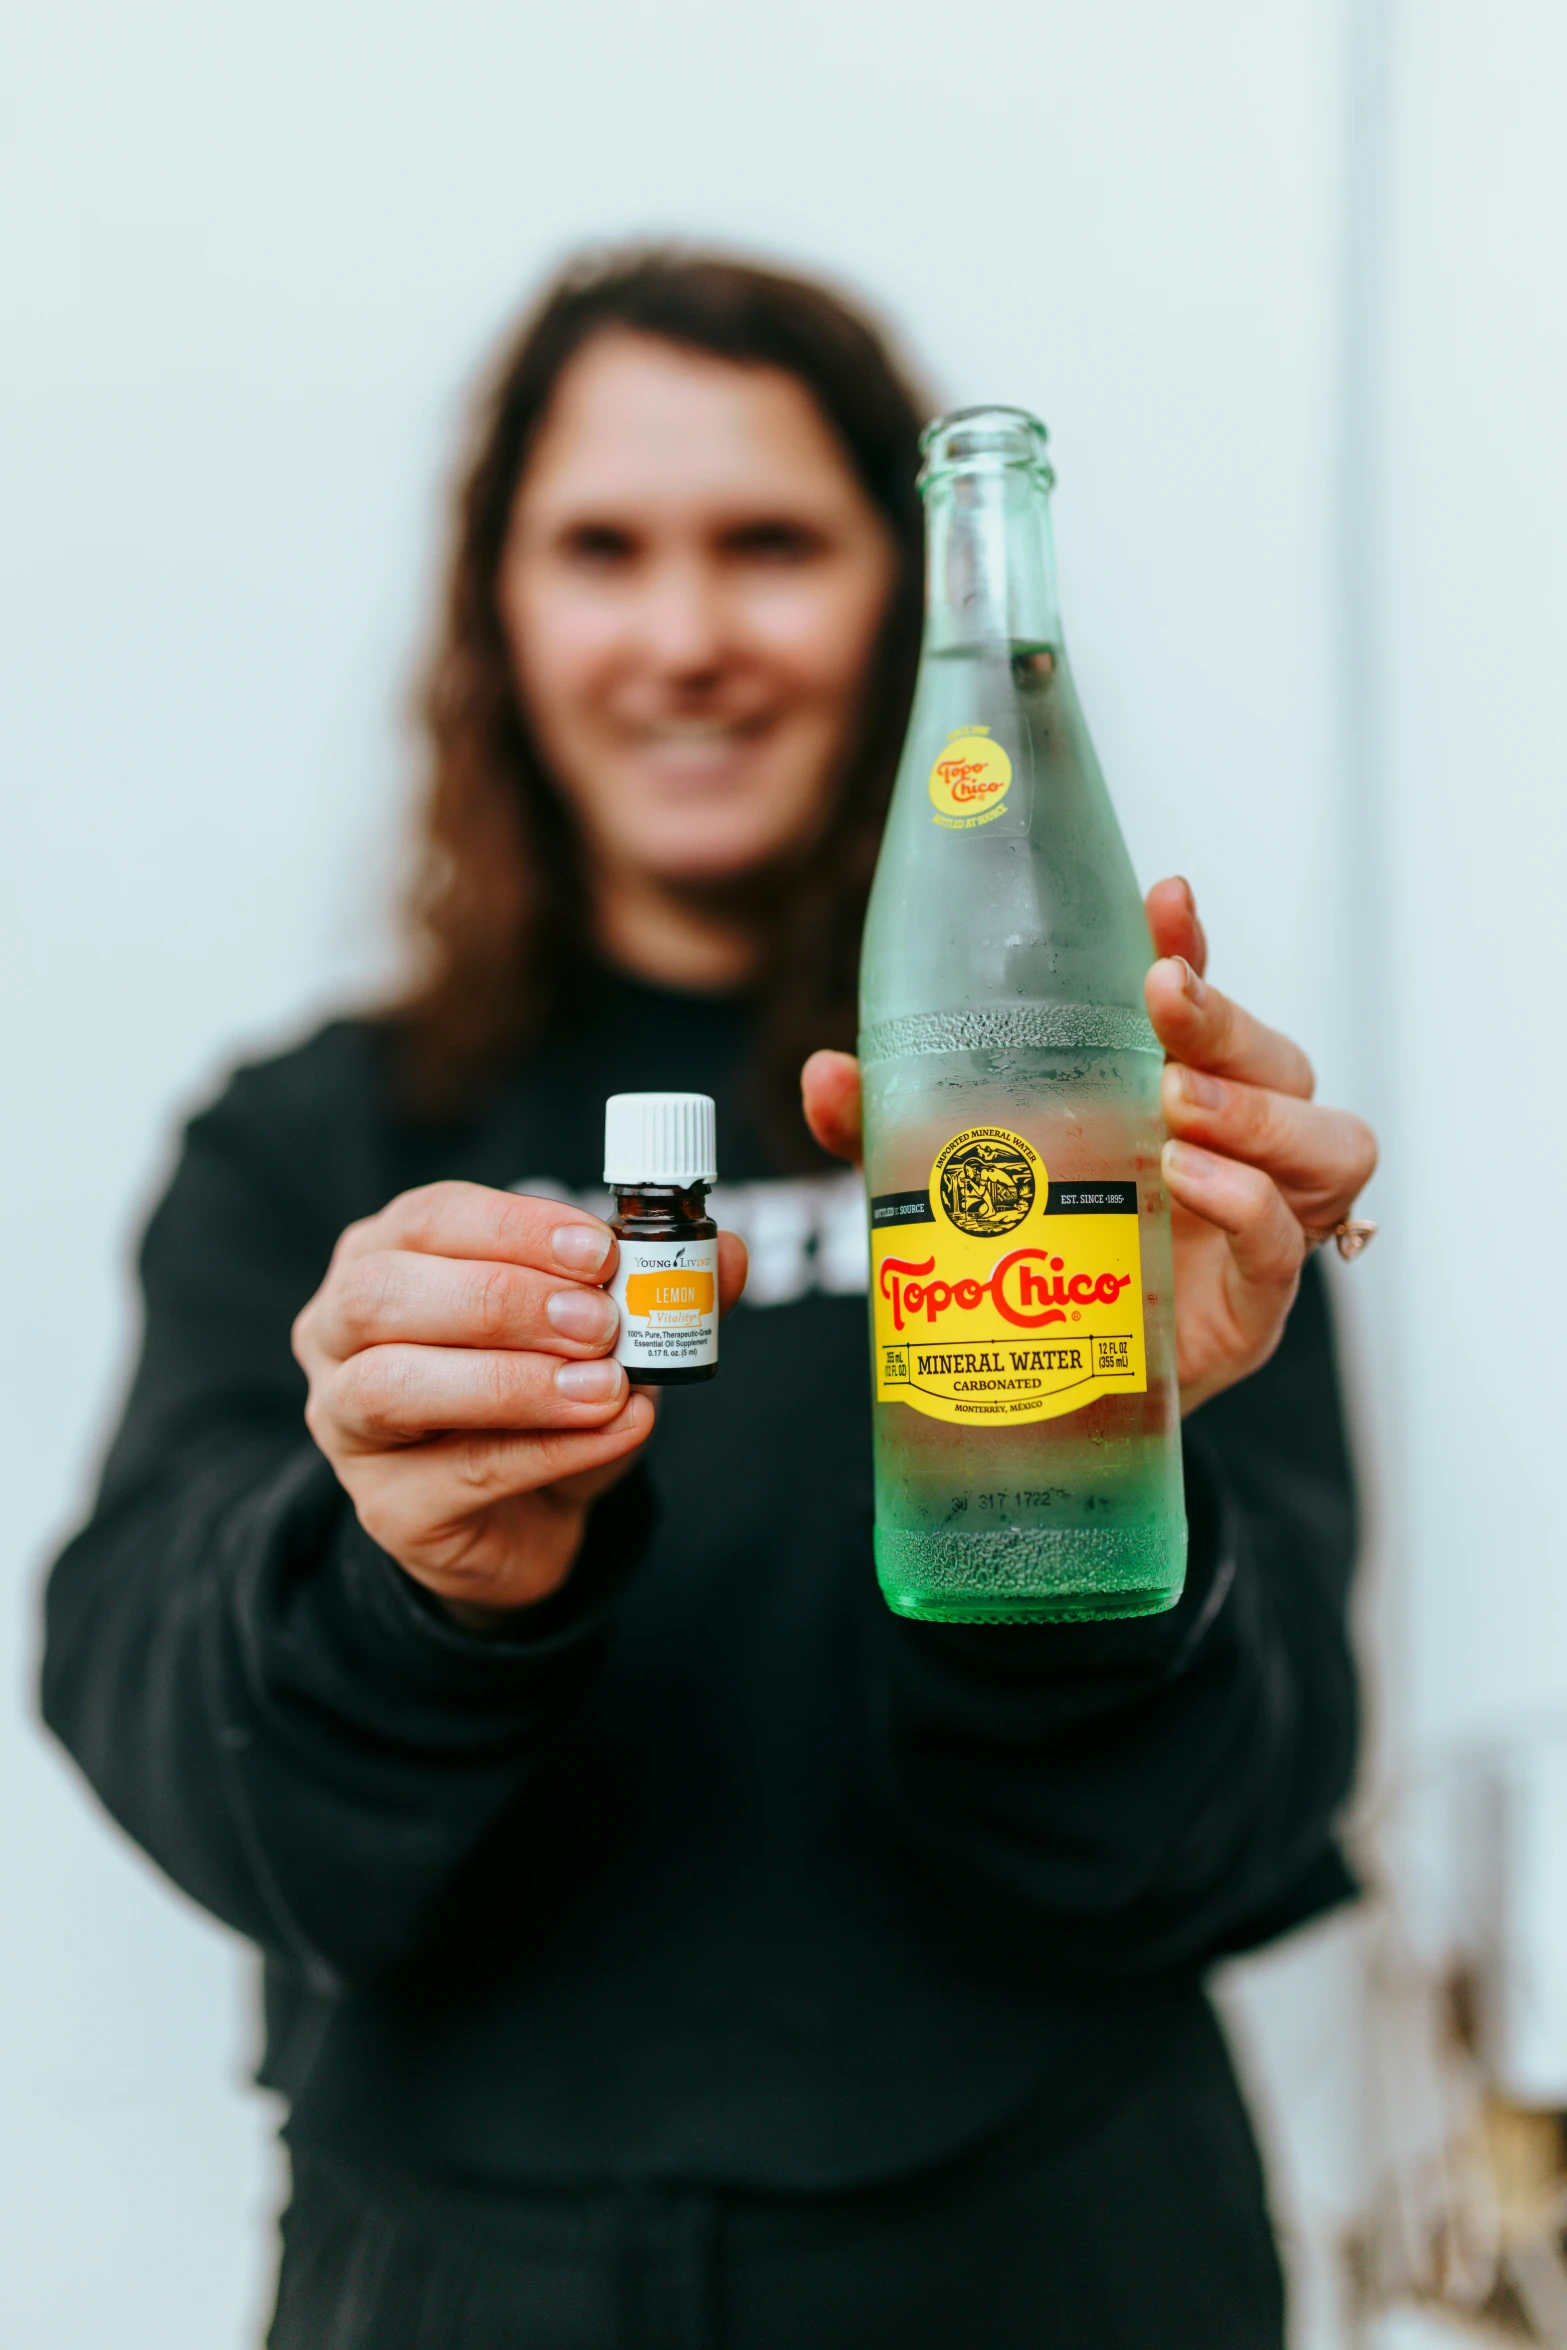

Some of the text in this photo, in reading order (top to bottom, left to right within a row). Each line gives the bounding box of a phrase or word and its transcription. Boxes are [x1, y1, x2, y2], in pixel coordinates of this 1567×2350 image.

[936, 757, 988, 785] Topo
[951, 778, 1004, 803] Chico
[935, 1129, 1038, 1170] IMPORTED MINERAL WATER
[1060, 1194, 1079, 1205] EST.
[1080, 1193, 1104, 1205] SINCE
[899, 1203, 925, 1215] SOURCE
[656, 1286, 695, 1304] LEMON
[880, 1248, 1132, 1331] Topo Chico
[628, 1328, 712, 1340] 100% Pure, Therapeutic-Grade
[634, 1339, 663, 1348] Essential
[676, 1338, 708, 1348] Supplement
[1098, 1341, 1128, 1355] 12 FL OZ
[648, 1349, 662, 1357] 0.17
[681, 1348, 688, 1357] (5
[917, 1349, 1083, 1376] MINERAL WATER
[1098, 1355, 1129, 1369] (355 mL)
[953, 1378, 1042, 1391] CARBONATED
[954, 1399, 1043, 1415] MONTERREY, MÉXICO
